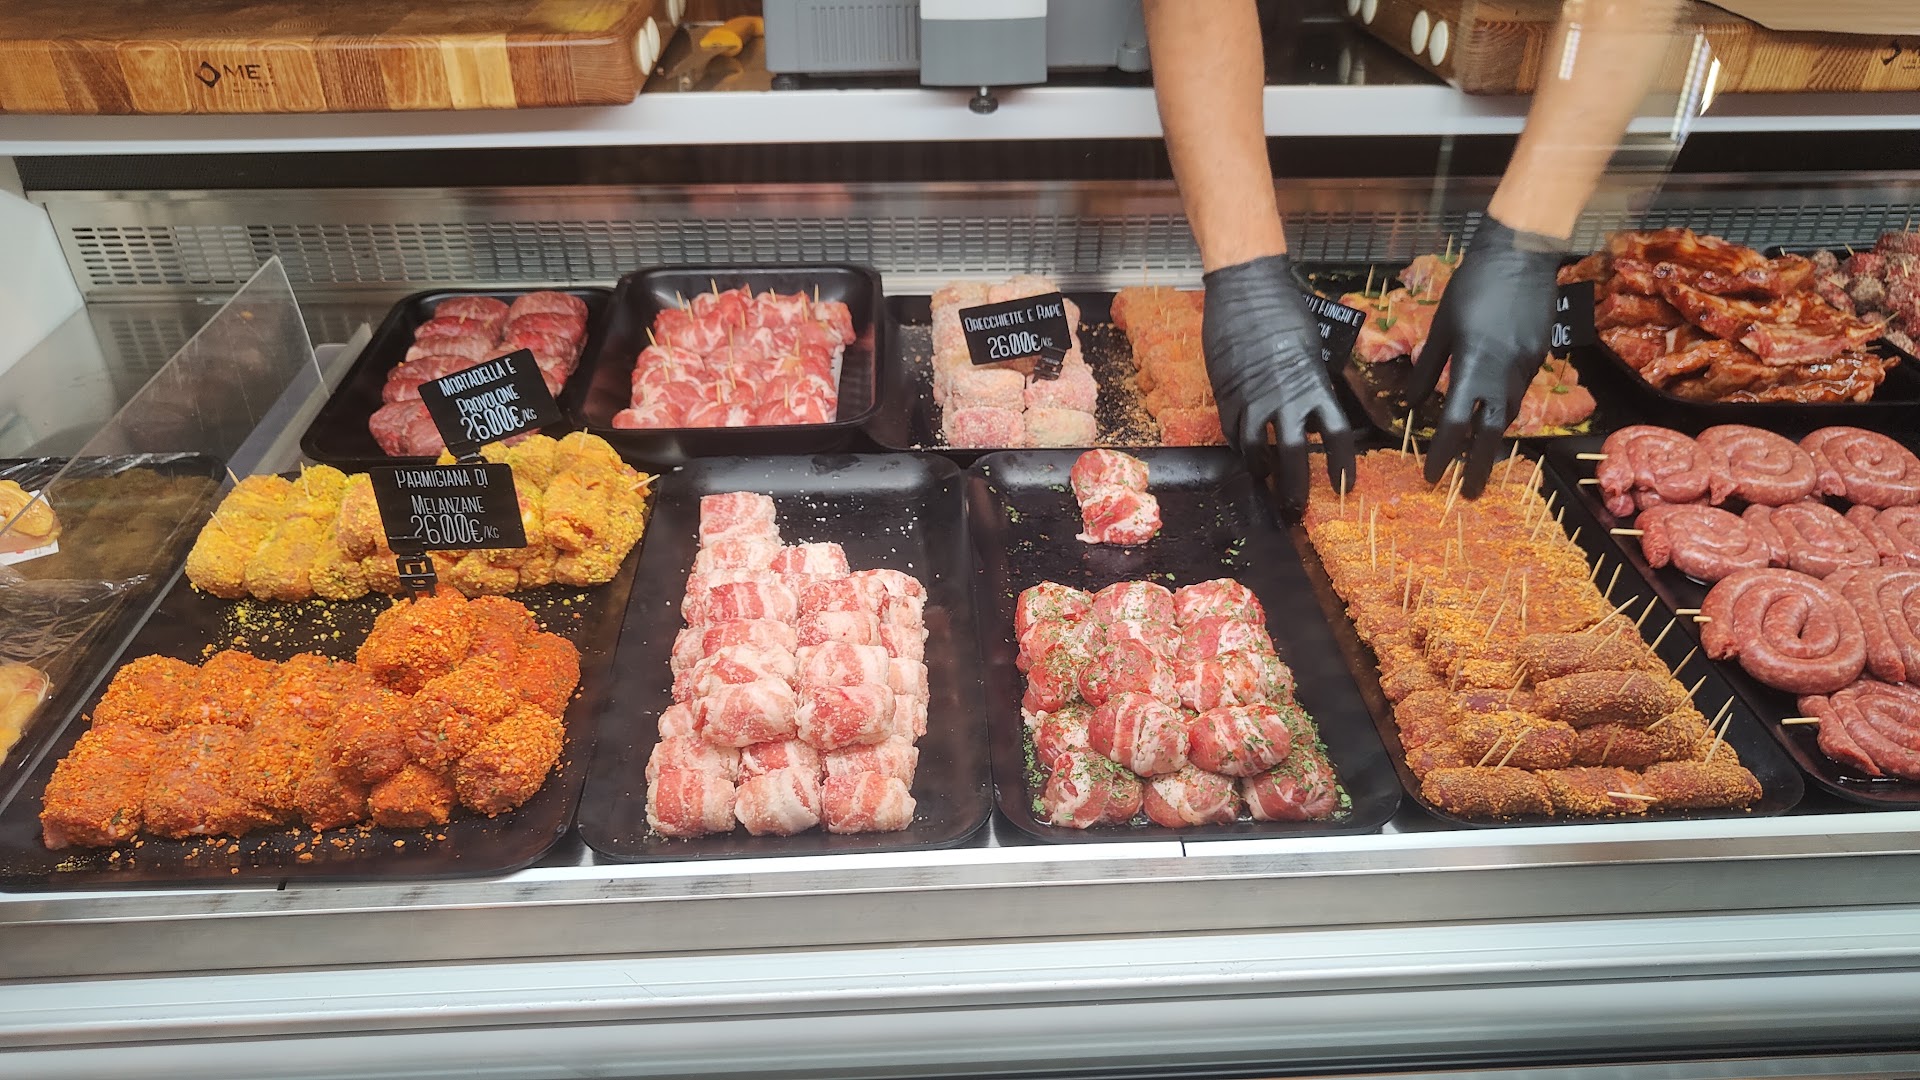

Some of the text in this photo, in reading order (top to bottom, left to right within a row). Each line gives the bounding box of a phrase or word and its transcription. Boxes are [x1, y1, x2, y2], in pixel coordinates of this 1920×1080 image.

[964, 303, 1063, 333] ORECCHIETTE E RAPE
[438, 357, 517, 397] MORTADELLA E
[455, 383, 521, 417] PROVOLONE
[394, 468, 489, 488] PARMIGIANA DI
[411, 494, 486, 515] MELANZANE
